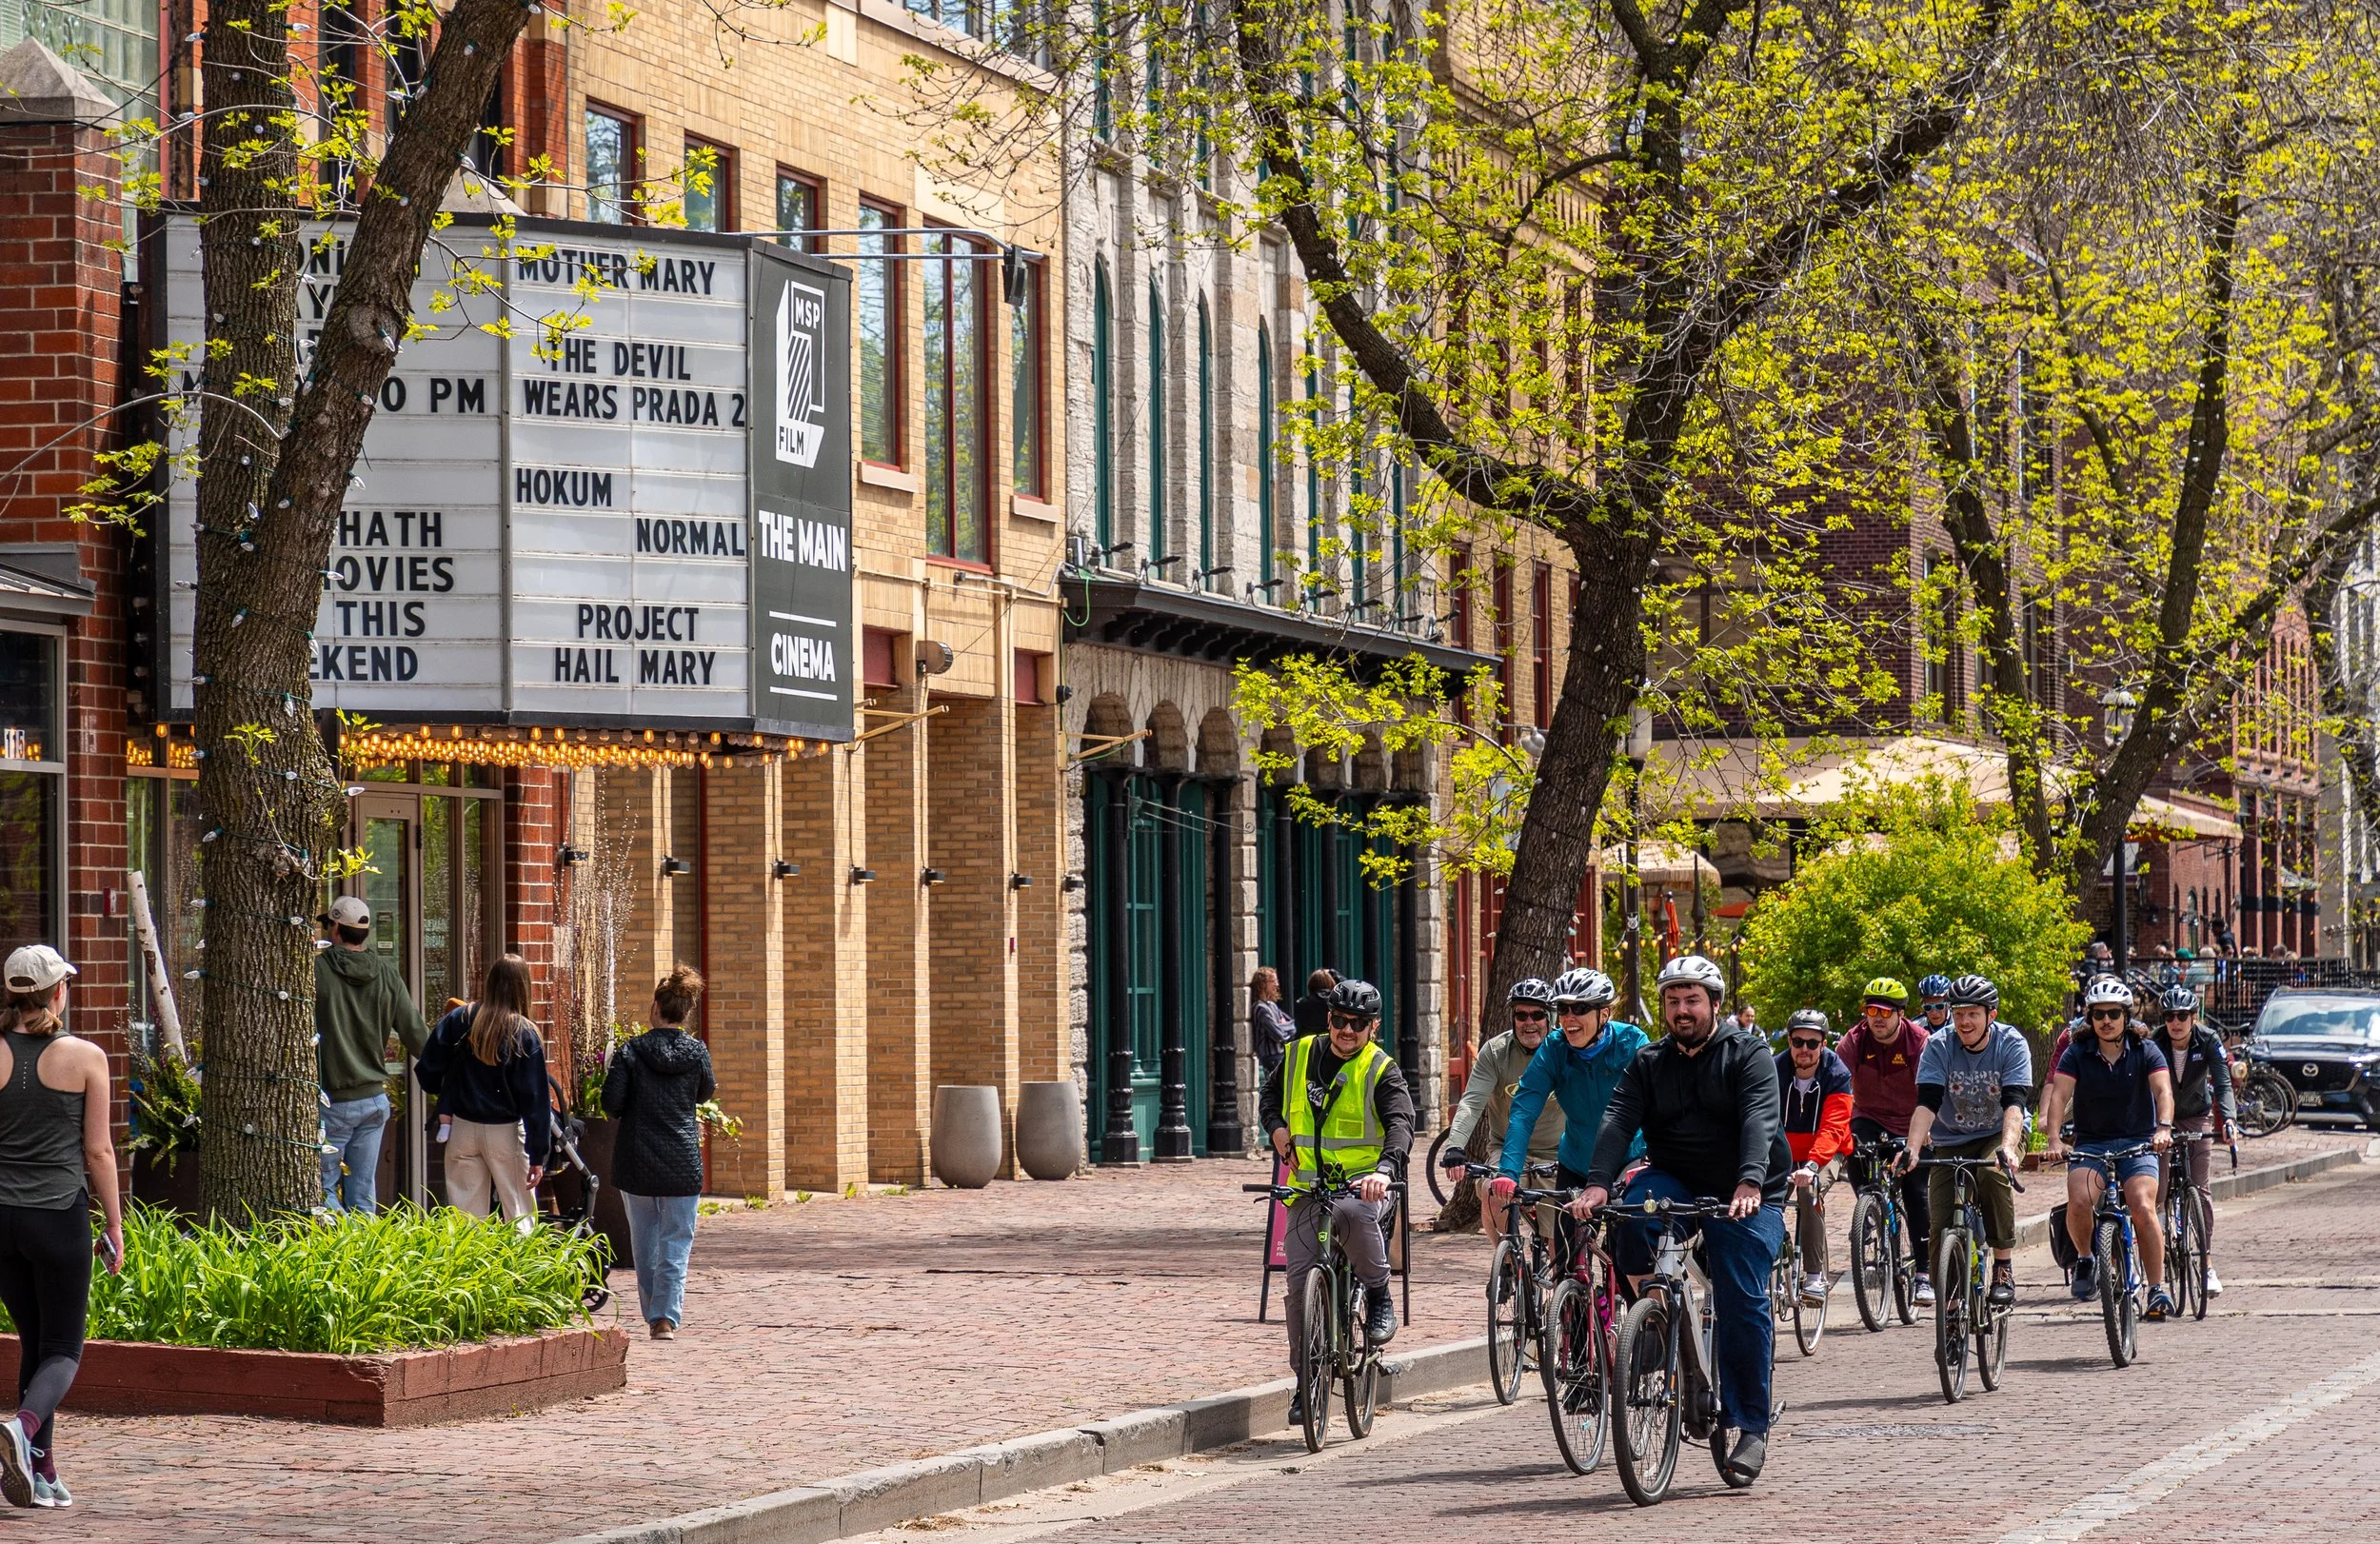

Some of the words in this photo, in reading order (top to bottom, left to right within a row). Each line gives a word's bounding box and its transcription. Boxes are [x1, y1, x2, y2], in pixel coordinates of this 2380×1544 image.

[518, 245, 629, 289] MOTHER
[640, 257, 716, 295] MARY
[795, 297, 821, 329] MSP
[545, 336, 597, 374] THE
[614, 342, 691, 381] DEVIL
[430, 377, 485, 413] PM
[524, 379, 618, 420] WEARS
[632, 386, 719, 426] PRADA
[731, 393, 745, 427] 2
[779, 426, 804, 456] FILM
[516, 467, 612, 506] HOKUM
[340, 510, 442, 547] HATH
[637, 518, 745, 557] NORMAL
[759, 509, 794, 563] THE
[798, 518, 846, 572] MAIN
[336, 601, 426, 638] THIS
[578, 604, 699, 642] PROJECT
[555, 647, 620, 683] HAIL
[640, 649, 716, 685] MARY
[770, 632, 836, 682] CINEMA
[6, 730, 24, 759] 115
